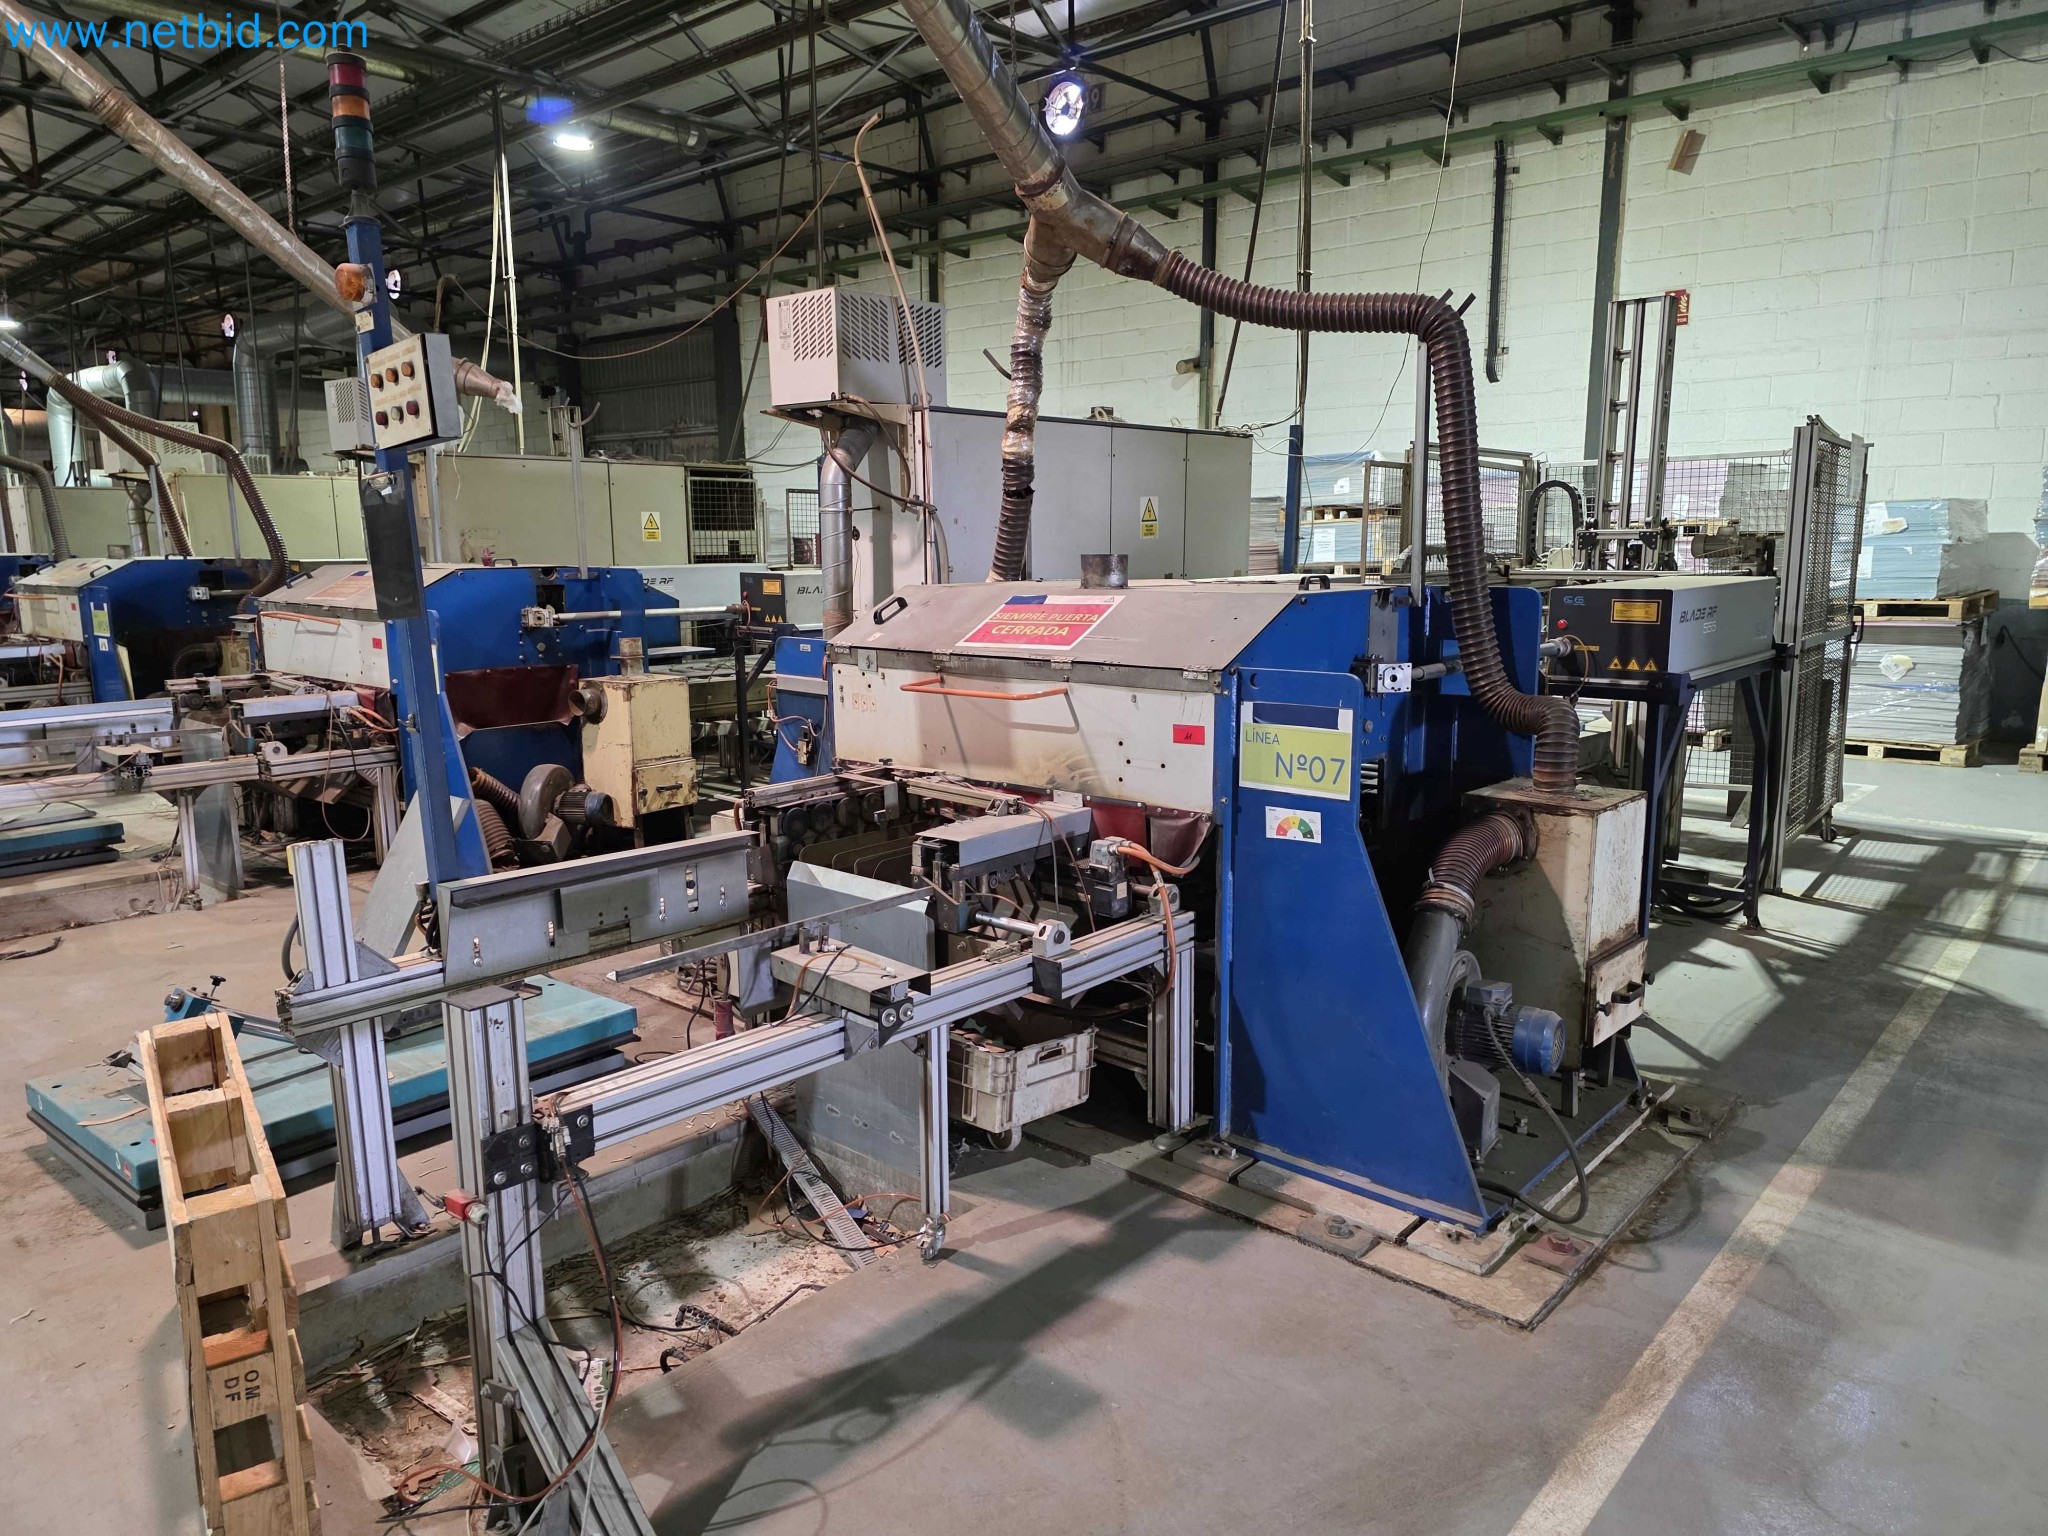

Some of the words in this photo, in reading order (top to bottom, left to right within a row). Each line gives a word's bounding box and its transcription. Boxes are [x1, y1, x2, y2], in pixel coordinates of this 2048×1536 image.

[991, 612, 1048, 621] SIEMPRE
[1048, 613, 1100, 622] PUERTA
[1679, 607, 1706, 623] BLADE
[1707, 605, 1718, 619] RF
[991, 624, 1070, 636] CERRADA
[1245, 727, 1280, 746] LÍNEA
